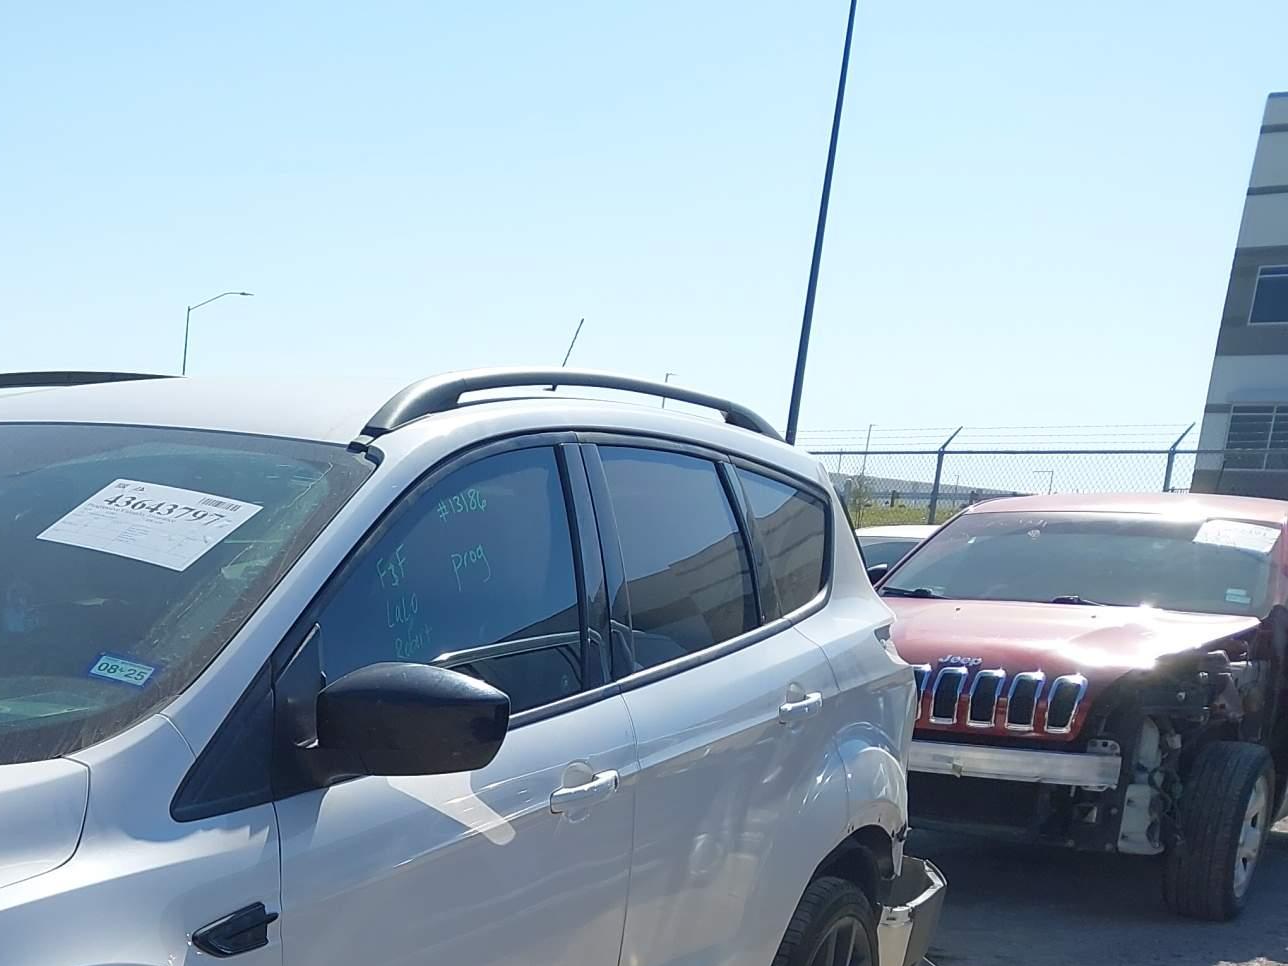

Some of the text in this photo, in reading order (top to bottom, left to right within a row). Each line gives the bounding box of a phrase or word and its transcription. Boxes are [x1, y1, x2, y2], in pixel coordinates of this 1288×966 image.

[103, 494, 225, 527] 43643797
[437, 488, 487, 521] #13186
[938, 654, 982, 666] Jeep
